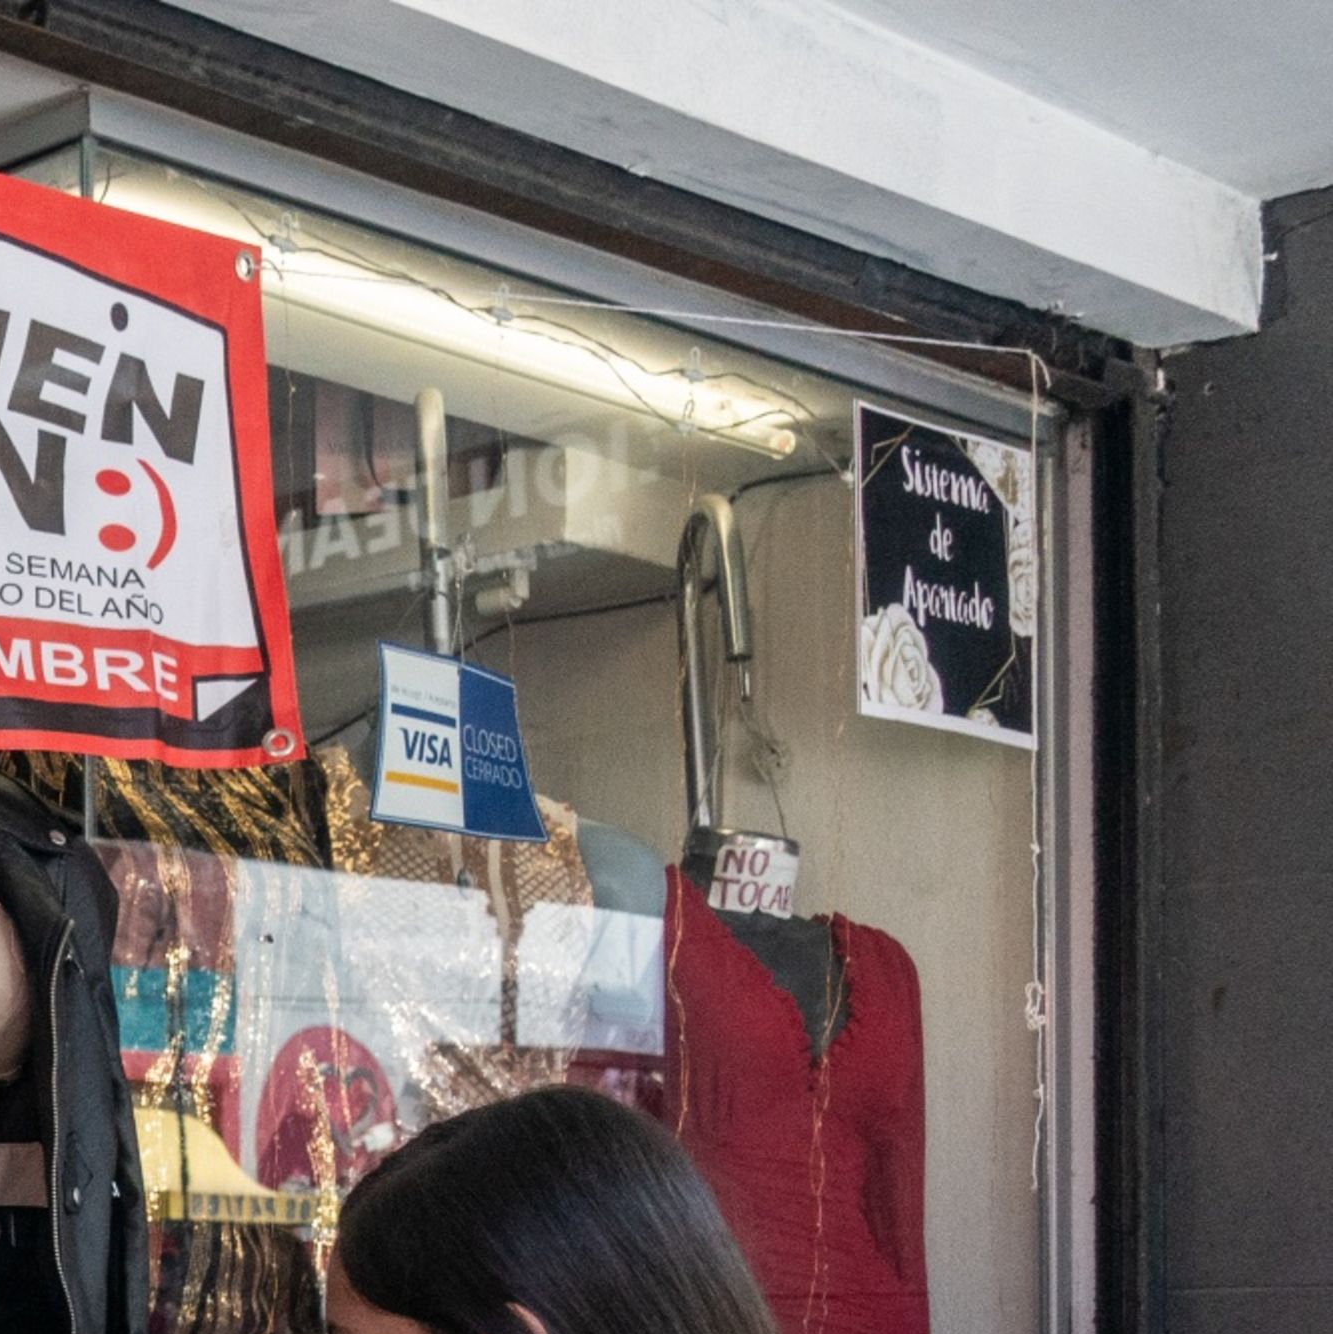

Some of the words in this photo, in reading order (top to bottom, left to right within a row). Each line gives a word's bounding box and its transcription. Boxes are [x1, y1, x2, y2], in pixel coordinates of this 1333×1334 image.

[900, 445, 990, 514] Sistema
[929, 511, 953, 562] de
[5, 552, 147, 590] SEMANA
[34, 586, 93, 617] DEL
[100, 592, 165, 626] AÑO
[902, 564, 995, 628] Apartado
[399, 727, 453, 769] VISA
[462, 723, 518, 763] CLOSED
[464, 755, 523, 790] CERRADO
[722, 848, 770, 878] NO
